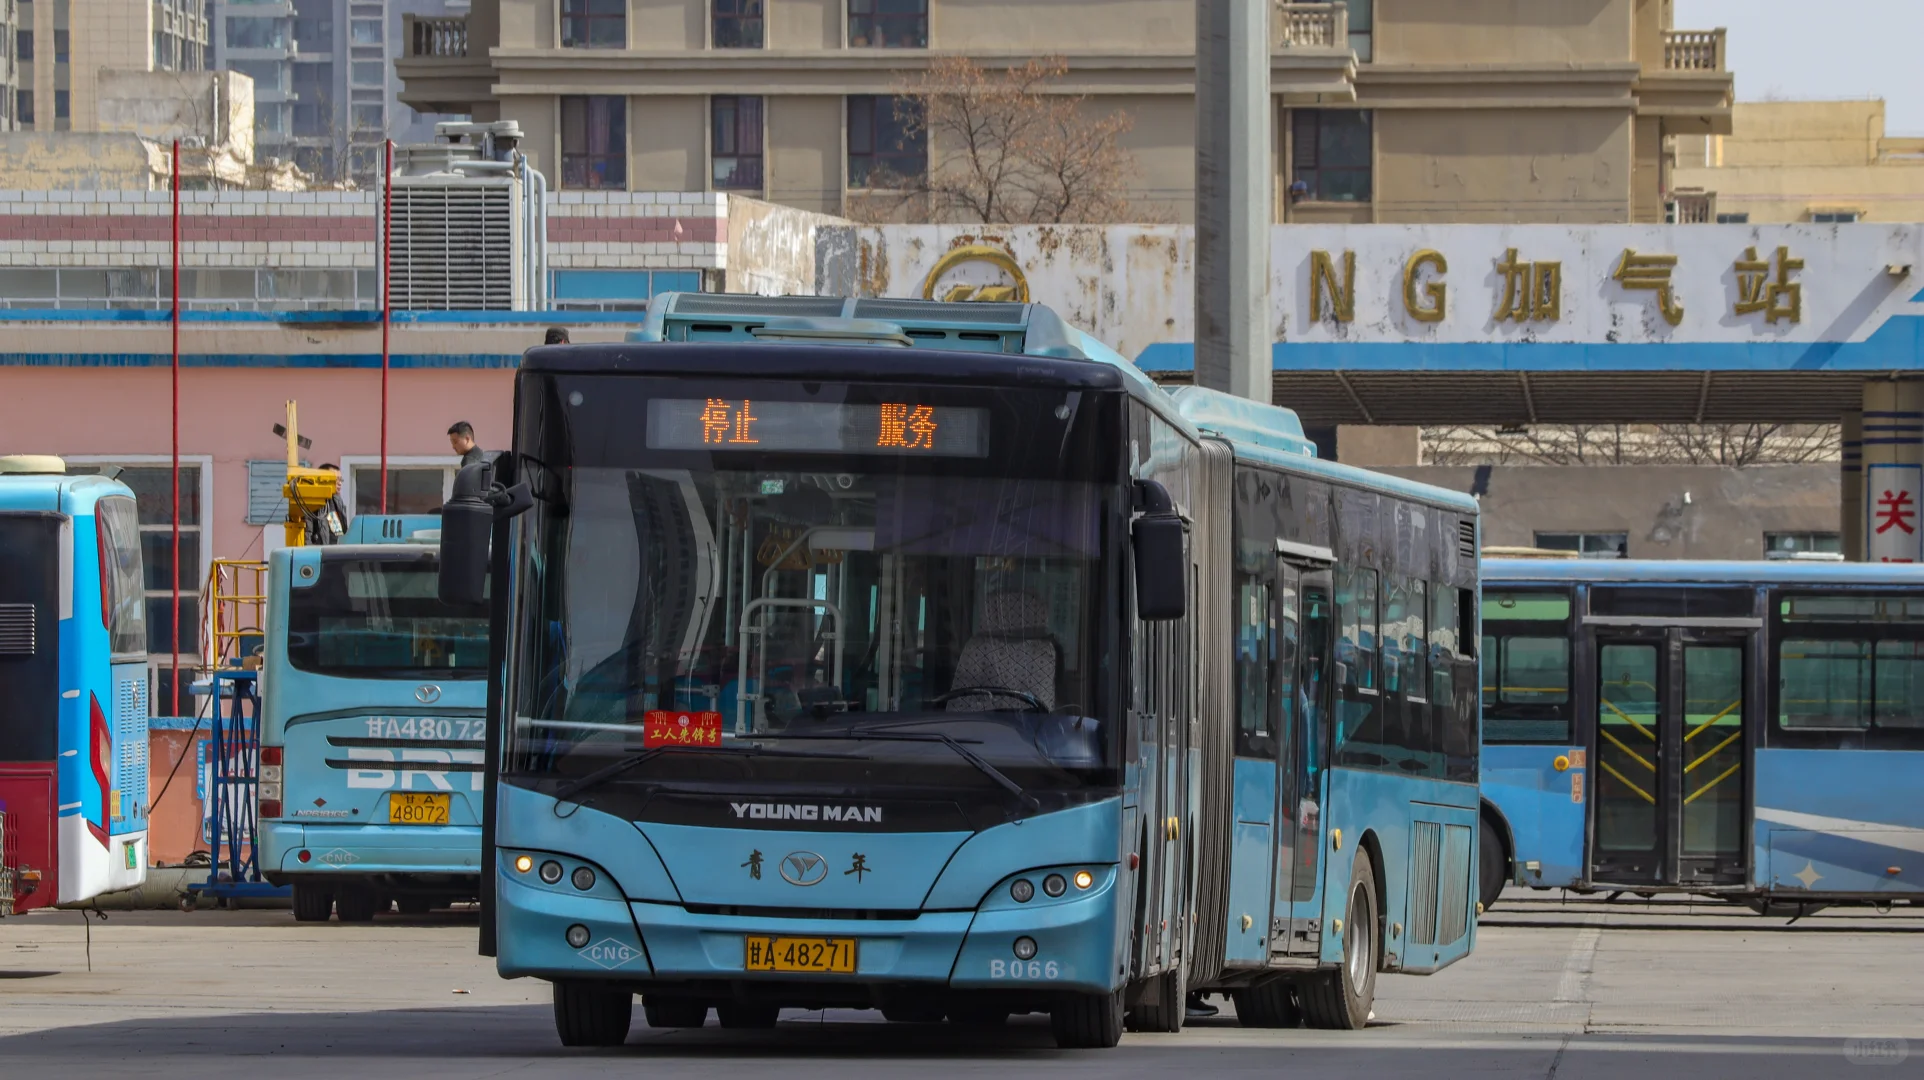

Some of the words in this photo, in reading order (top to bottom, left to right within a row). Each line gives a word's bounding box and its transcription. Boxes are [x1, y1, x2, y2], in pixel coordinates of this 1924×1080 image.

[699, 398, 759, 443] 停止
[877, 403, 937, 449] 服务
[1876, 490, 1915, 563] 关
[365, 716, 485, 740] 甘A48072
[650, 727, 717, 744] 工人先锋号
[393, 806, 445, 823] 48072
[326, 853, 353, 863] CNG
[591, 946, 630, 960] CNG
[990, 959, 1059, 979] B066
